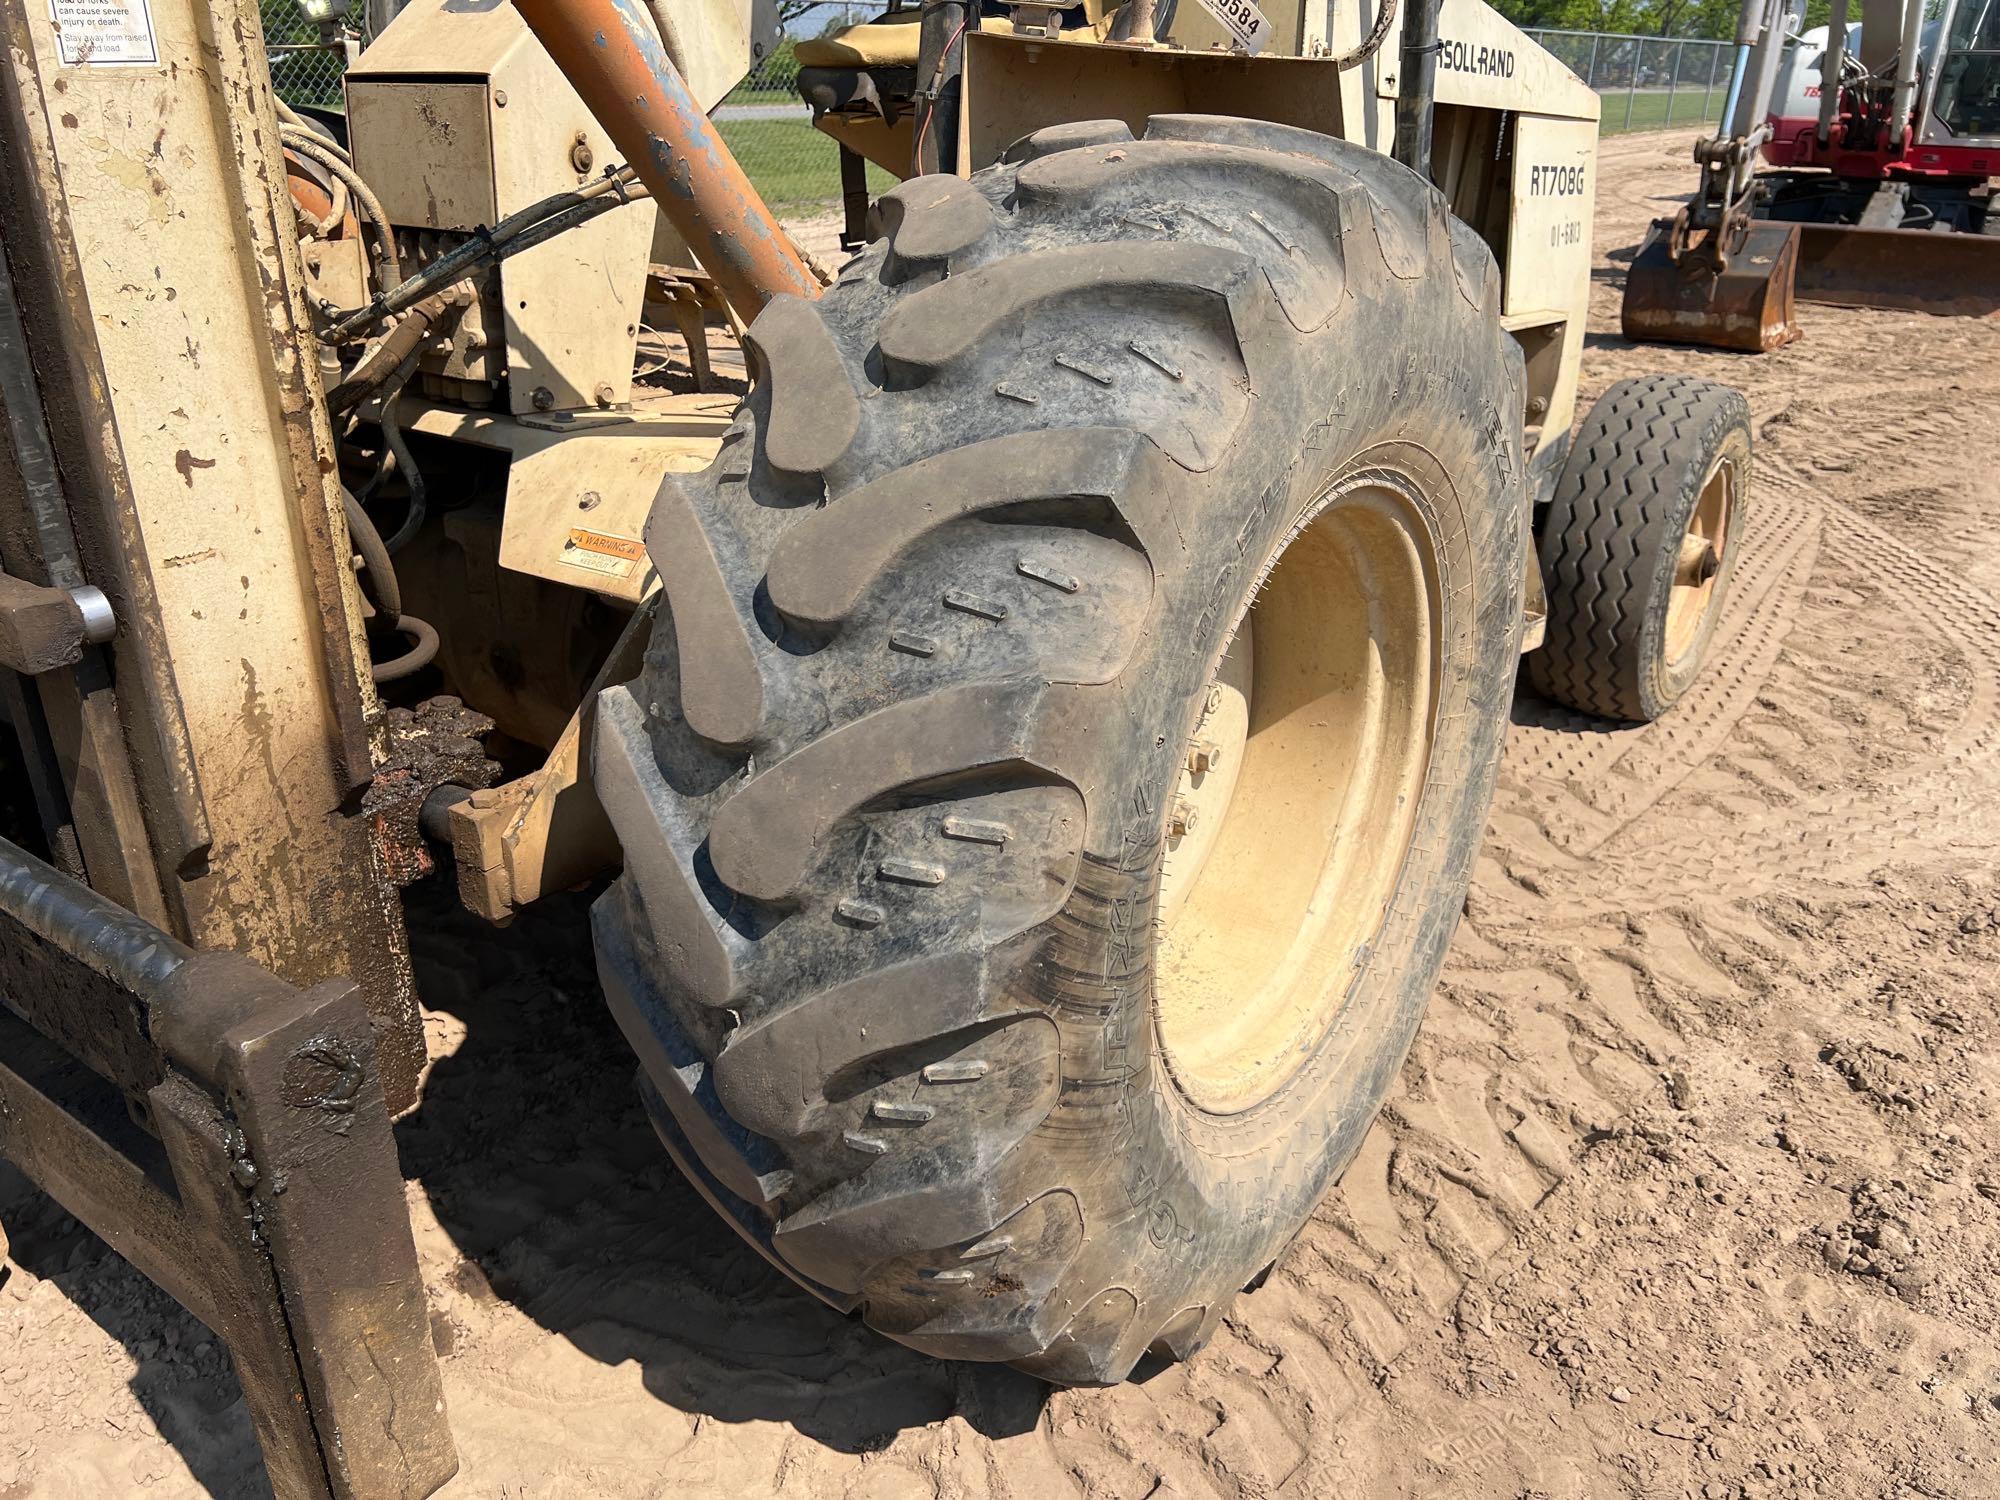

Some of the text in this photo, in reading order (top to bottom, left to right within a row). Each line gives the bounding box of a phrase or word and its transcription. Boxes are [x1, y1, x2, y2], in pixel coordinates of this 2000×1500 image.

[61, 17, 84, 27] injury
[97, 17, 122, 26] death.
[1210, 1, 1229, 18] AUCTION
[1229, 17, 1250, 38] COMPANY
[64, 33, 148, 43] Stay away from raised
[1530, 165, 1585, 196] RT708G
[586, 536, 627, 552] WARNING
